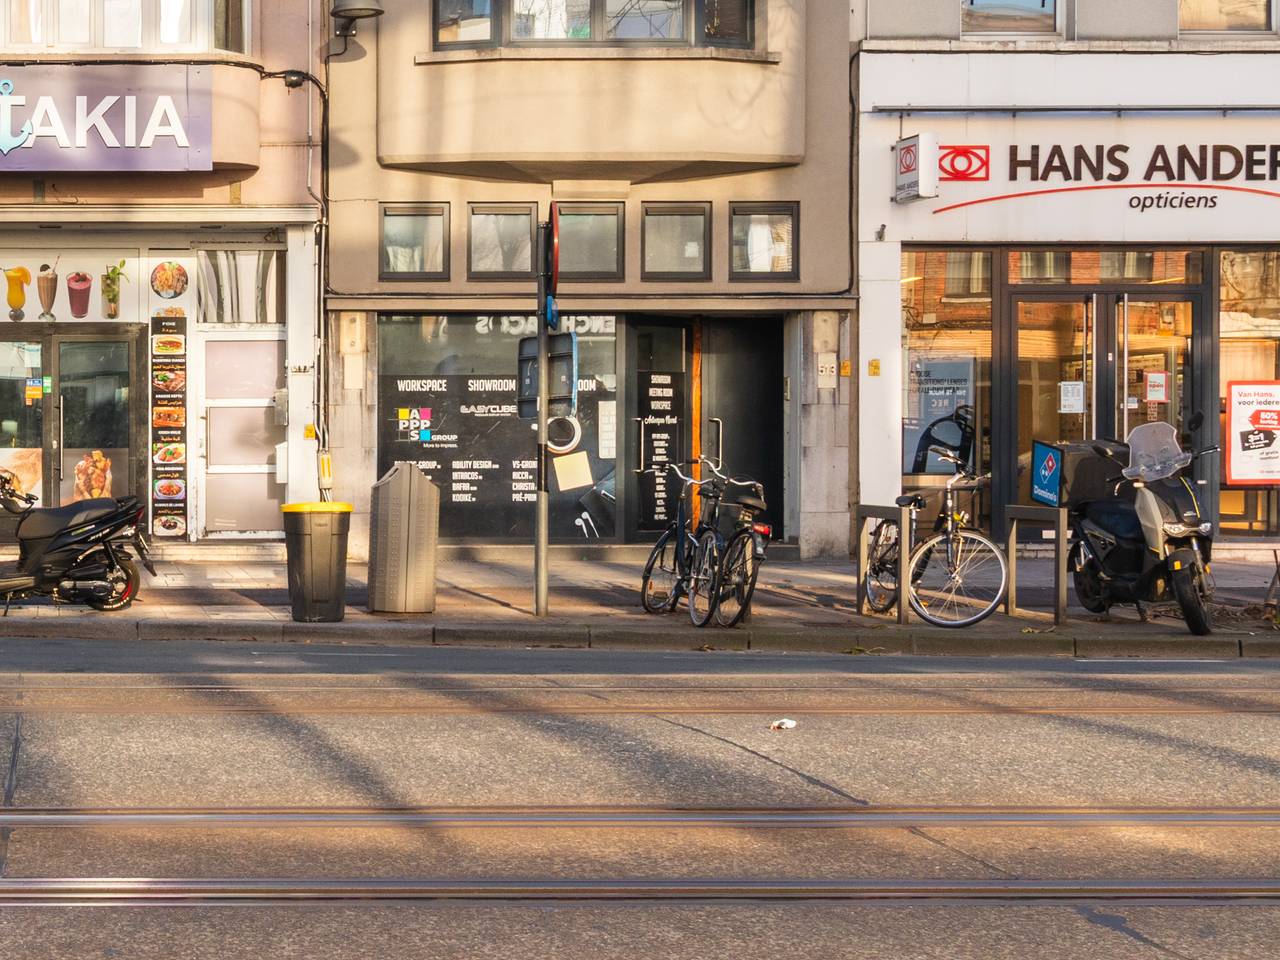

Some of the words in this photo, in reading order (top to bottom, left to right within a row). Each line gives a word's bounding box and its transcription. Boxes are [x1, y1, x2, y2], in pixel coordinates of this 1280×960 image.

[1008, 144, 1129, 182] HANS
[1128, 192, 1218, 212] opticiens
[397, 380, 447, 392] WORKSPACE
[468, 379, 516, 391] SHOWROOM
[576, 380, 596, 391] OOM
